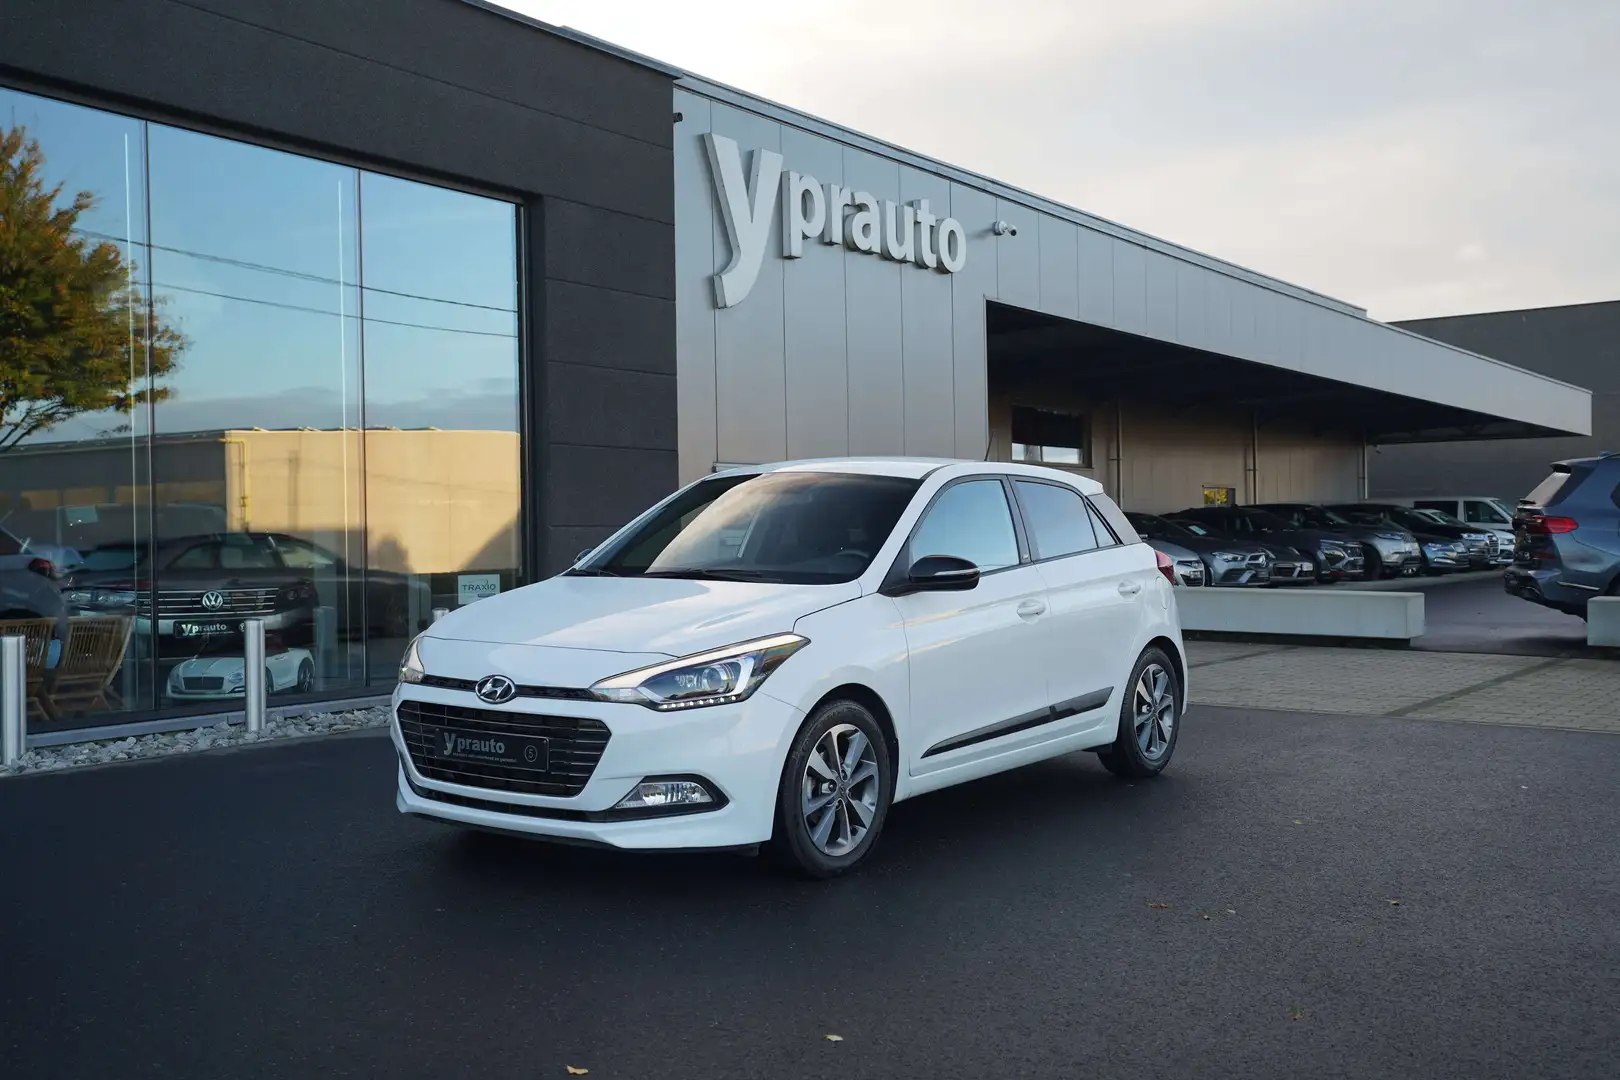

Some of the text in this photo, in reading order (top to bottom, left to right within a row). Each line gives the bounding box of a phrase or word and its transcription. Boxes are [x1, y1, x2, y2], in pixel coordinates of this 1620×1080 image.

[703, 132, 966, 309] yprauto
[462, 583, 497, 591] TRAXIO
[443, 732, 505, 756] yprauto
